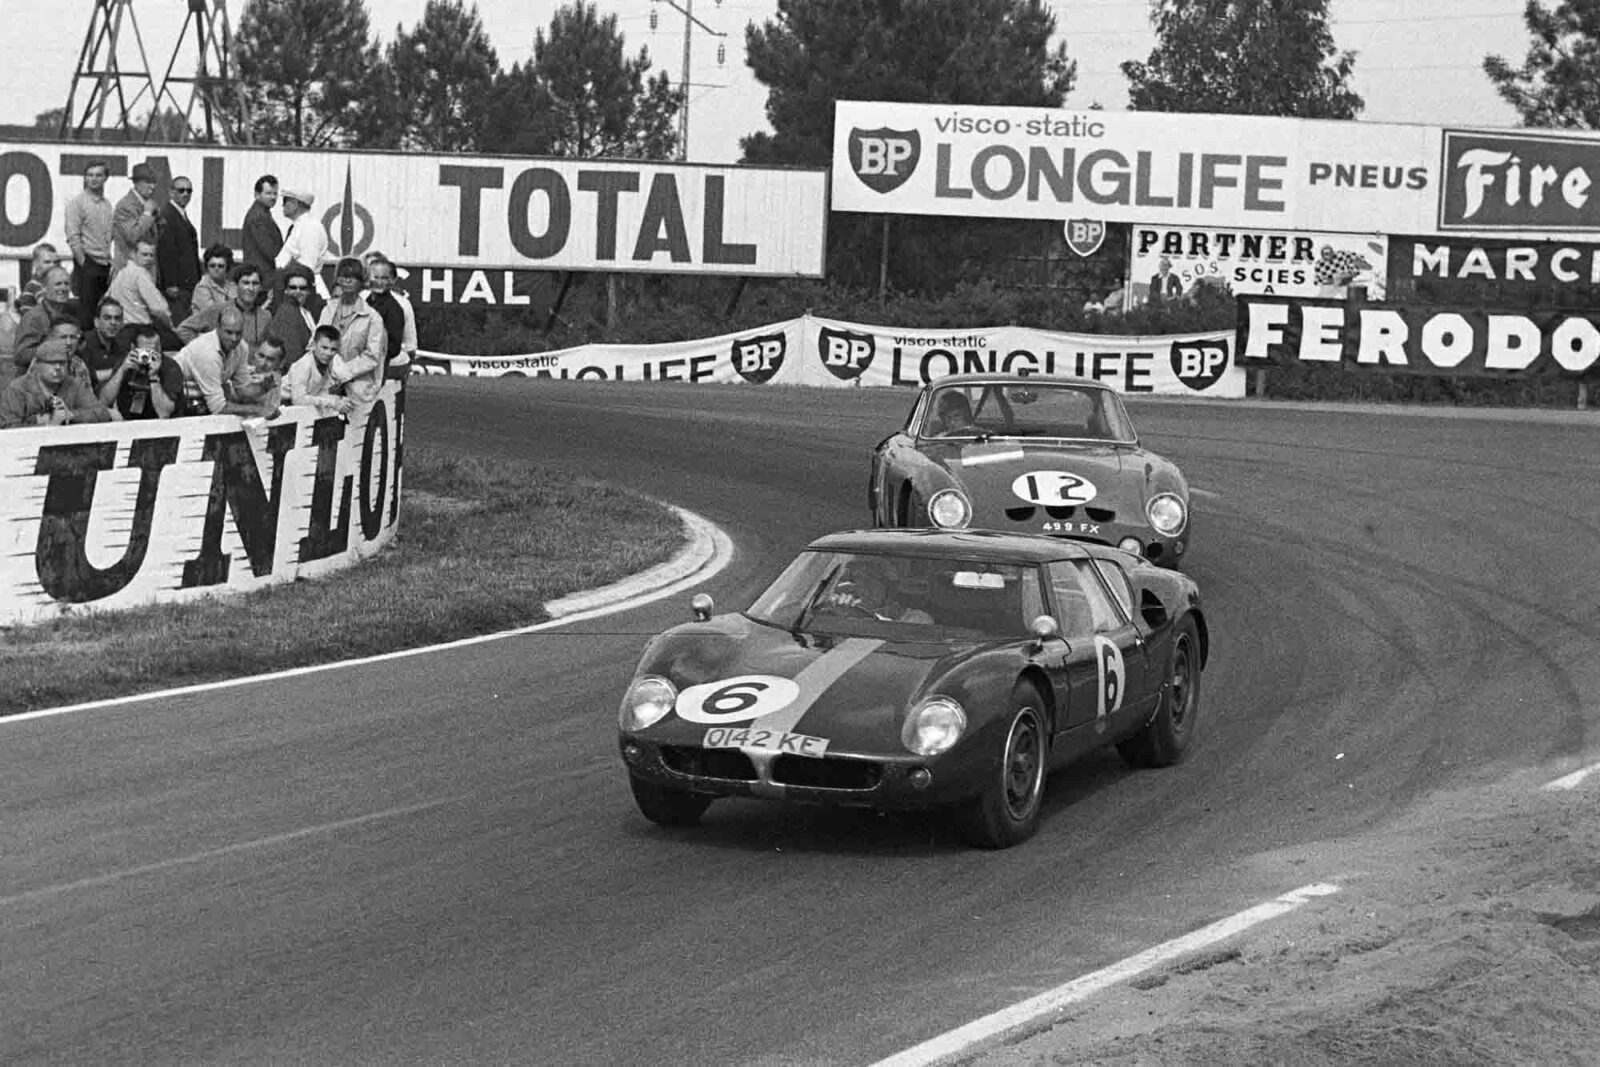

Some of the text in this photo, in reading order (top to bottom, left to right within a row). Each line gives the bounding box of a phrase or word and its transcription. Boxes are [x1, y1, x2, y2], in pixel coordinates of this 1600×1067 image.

[858, 137, 912, 176] BP
[934, 143, 1288, 213] LONGLIFE
[1309, 162, 1429, 190] PNEUS
[1456, 148, 1592, 220] Fire
[438, 164, 757, 265] TOTAL
[1071, 222, 1101, 244] BP
[1138, 229, 1317, 261] PARTNER
[1234, 267, 1306, 285] SCIES
[825, 338, 872, 368] BP
[1244, 303, 1600, 371] FERODO
[739, 340, 782, 373] BP
[1178, 345, 1224, 377] BP
[1026, 475, 1087, 501] 12
[1080, 523, 1100, 534] FX
[1104, 643, 1119, 715] 6
[702, 682, 770, 714] 6
